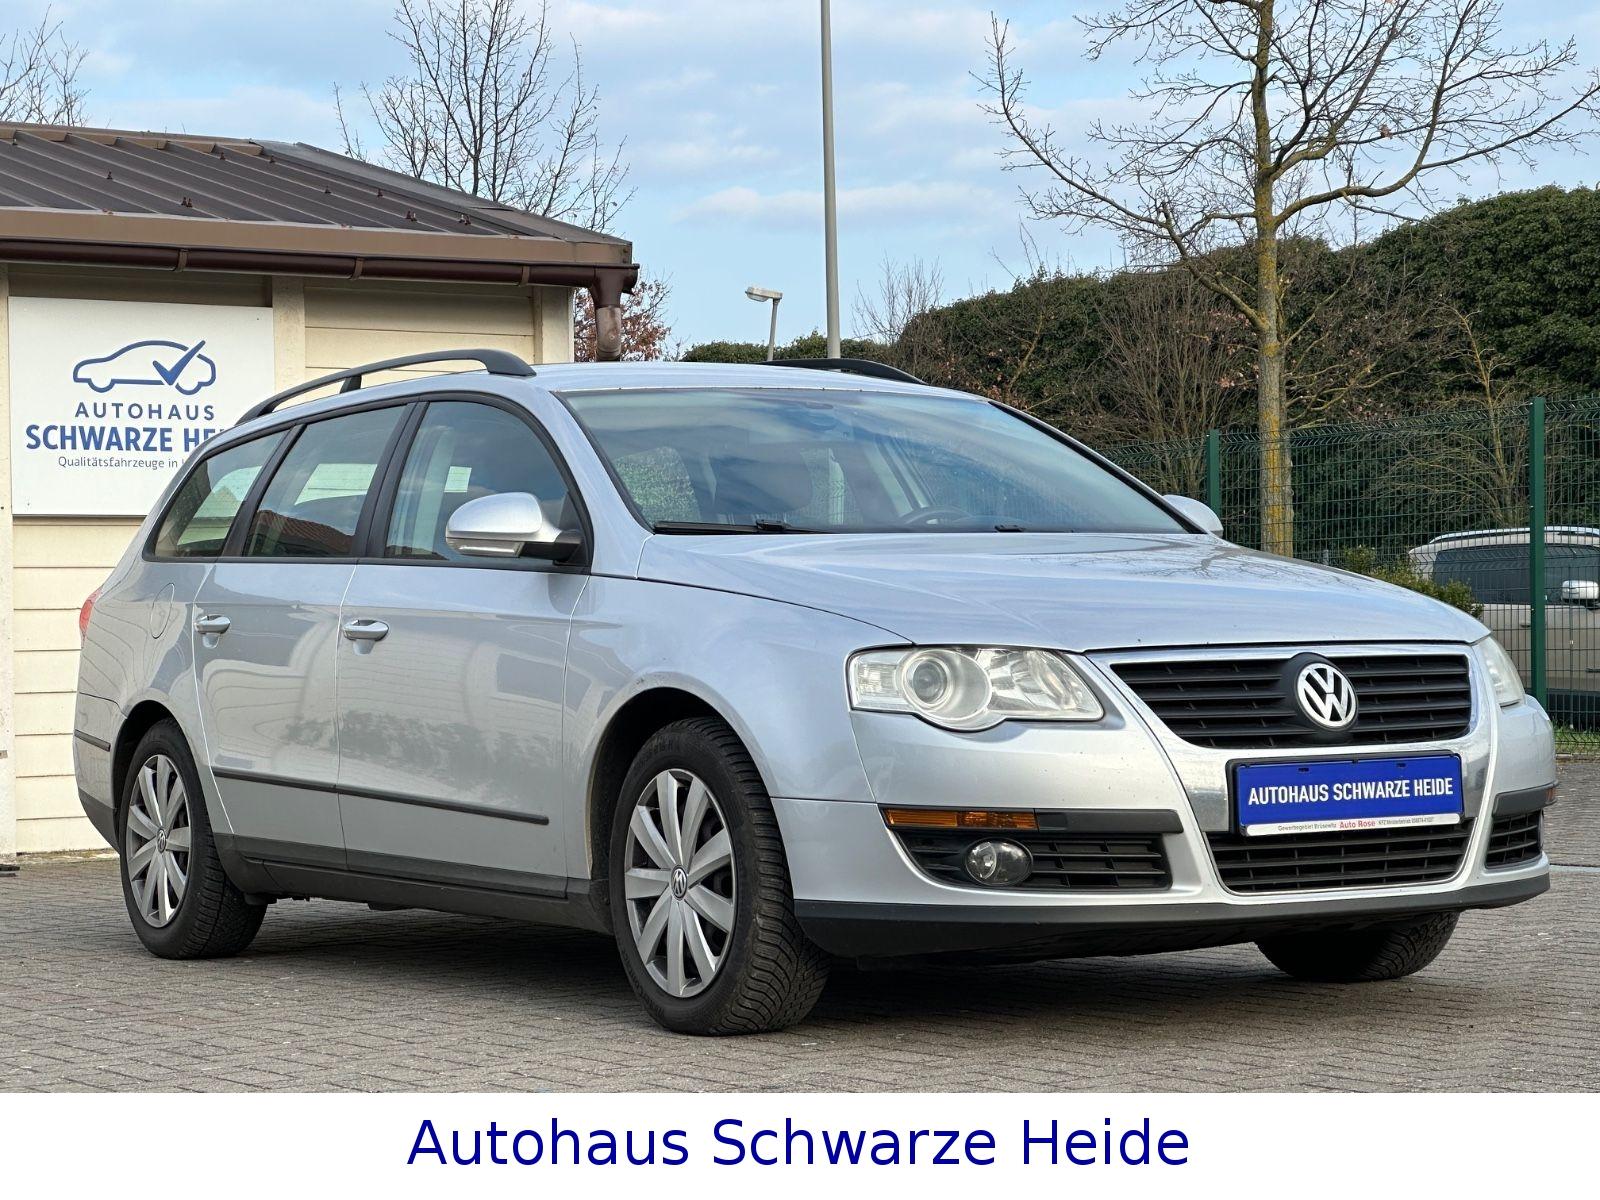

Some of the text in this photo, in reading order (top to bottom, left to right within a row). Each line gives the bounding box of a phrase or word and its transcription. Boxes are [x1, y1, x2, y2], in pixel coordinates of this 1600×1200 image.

[74, 402, 215, 421] AUTOHAUS
[25, 424, 173, 452] SCHWARZE
[58, 456, 165, 471] Qualitätsfahrzeuge
[168, 458, 178, 468] in
[1248, 777, 1454, 806] AUTOHAUS SCHWARZE HEIDE
[1339, 821, 1357, 830] Auto
[1357, 819, 1376, 829] Rose
